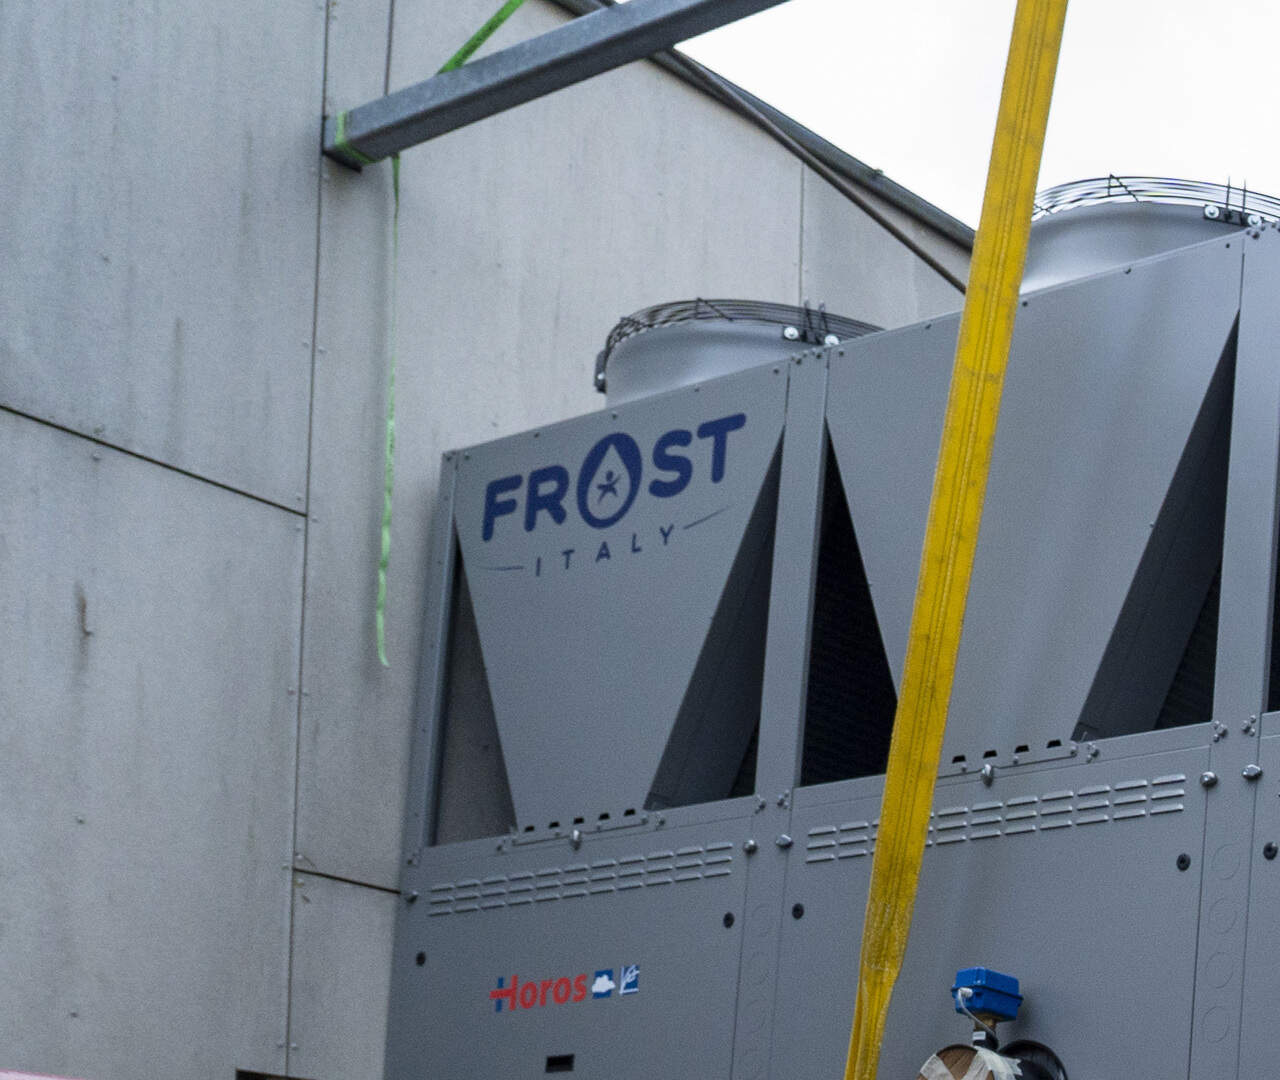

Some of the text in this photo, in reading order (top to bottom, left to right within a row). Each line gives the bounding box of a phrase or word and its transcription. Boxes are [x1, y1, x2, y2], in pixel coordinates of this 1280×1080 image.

[481, 412, 747, 542] FROST
[535, 524, 675, 577] ITALY
[489, 973, 588, 1013] Horos
